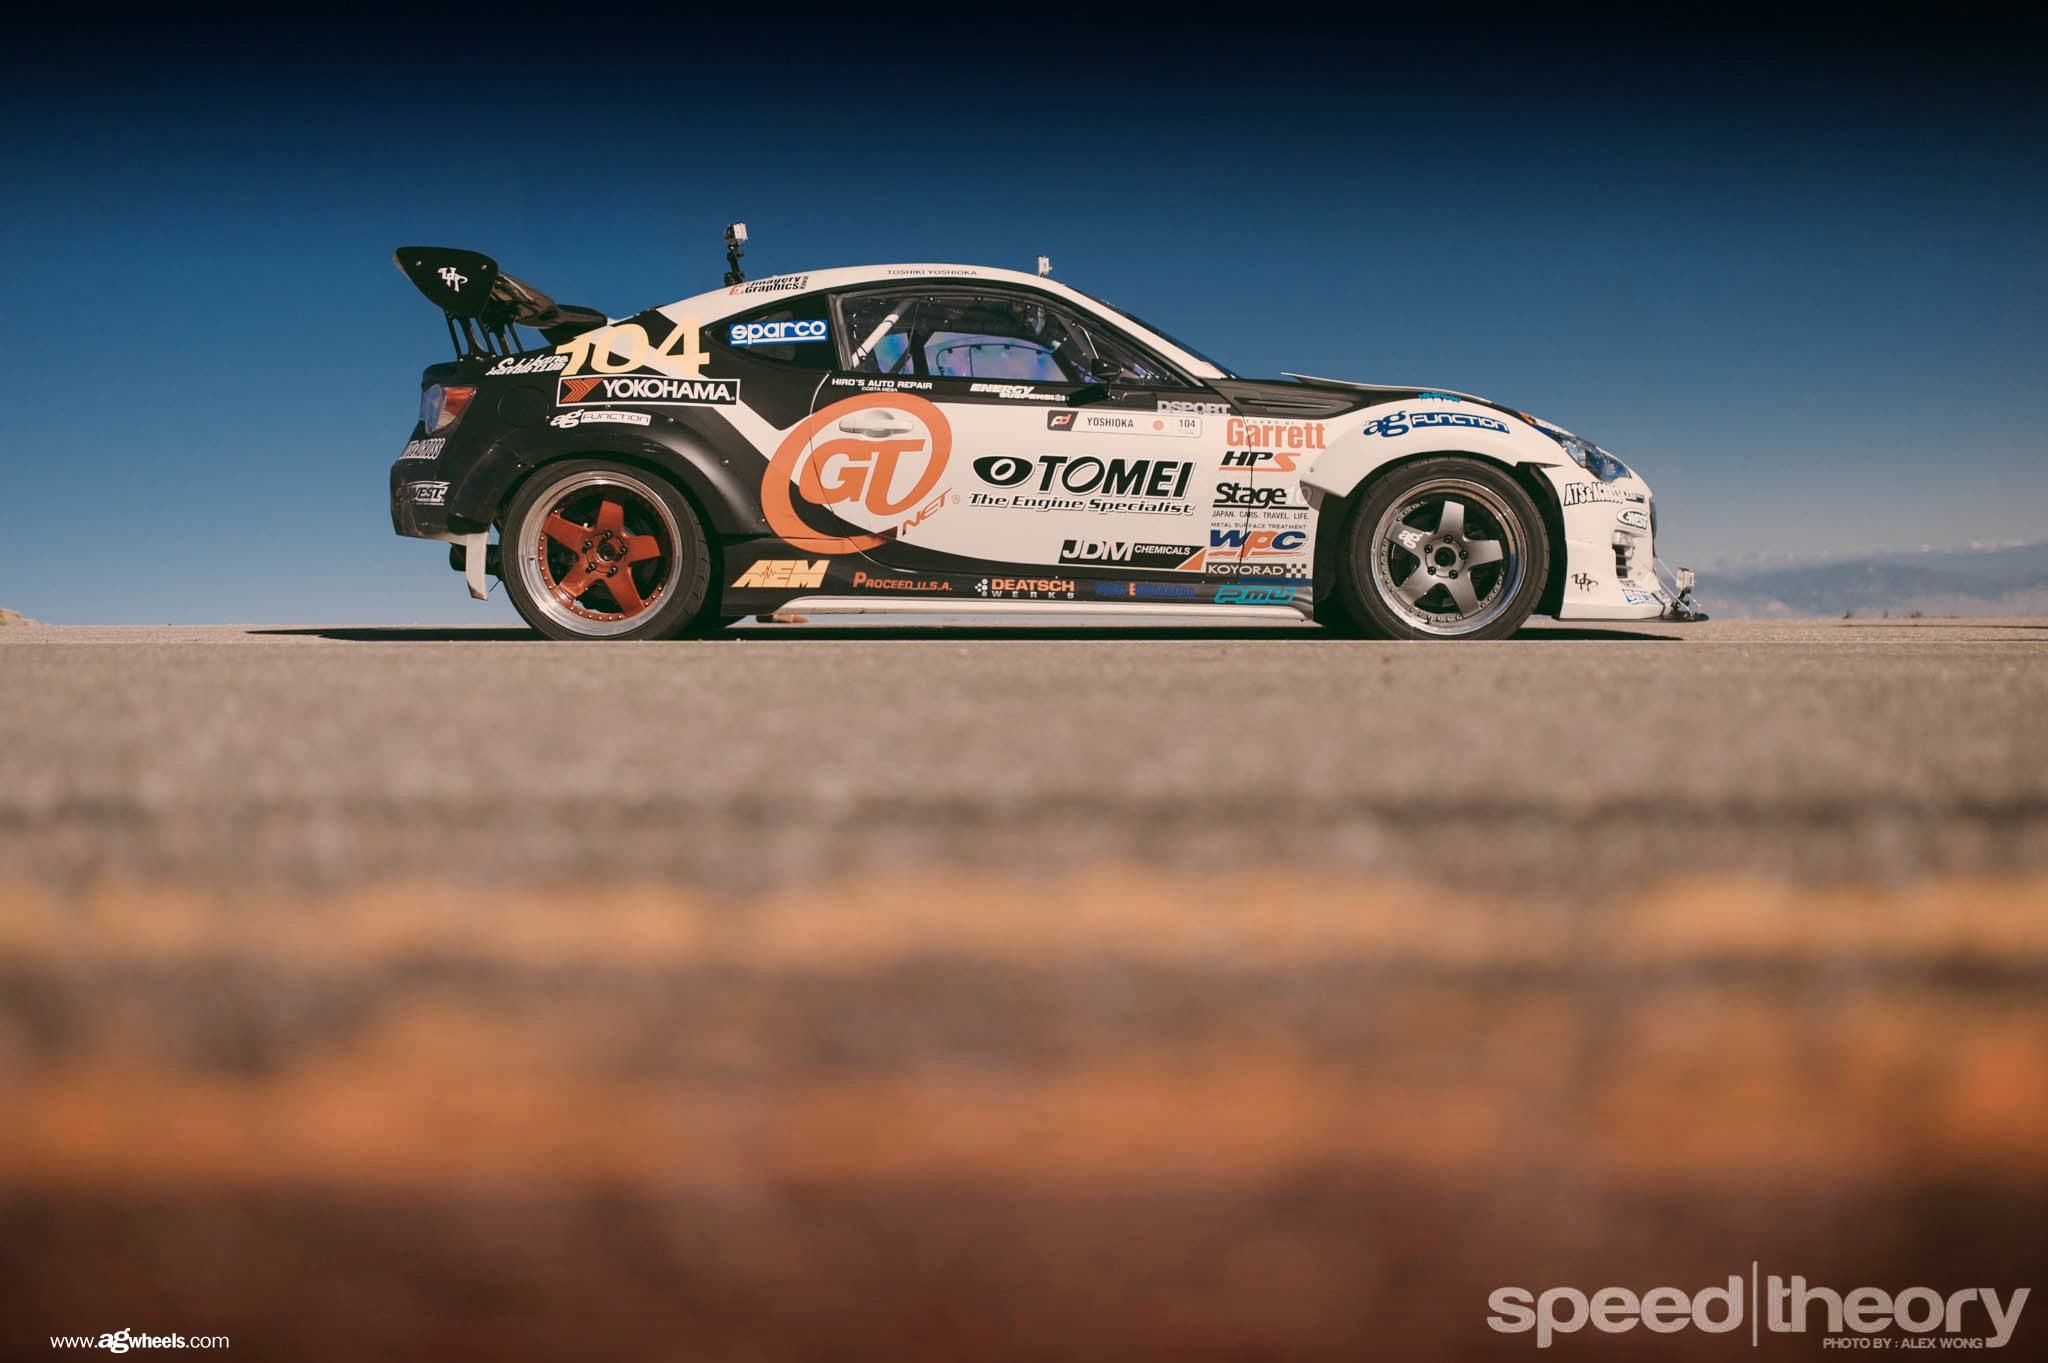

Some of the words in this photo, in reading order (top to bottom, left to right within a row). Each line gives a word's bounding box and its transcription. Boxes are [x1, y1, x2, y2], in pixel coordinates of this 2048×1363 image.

[744, 282, 800, 294] Graphics
[730, 320, 827, 345] sparco
[555, 315, 710, 376] 104
[831, 378, 865, 387] HIRO'S
[867, 379, 895, 389] AUTO
[897, 380, 933, 390] REPAIR
[1157, 400, 1231, 414] DSPORT
[1086, 416, 1134, 428] YOSHIOKA
[1179, 419, 1196, 428] 104
[1226, 418, 1326, 449] Garrett
[1219, 451, 1301, 472] HPS
[1038, 455, 1194, 498] TOMEI
[969, 493, 1008, 506] The
[1012, 495, 1084, 510] Engine
[1088, 498, 1195, 514] Specialist
[1211, 510, 1235, 518] JAPAN.
[1263, 512, 1291, 520] TRAVEL.
[1062, 540, 1135, 561] JDM
[1134, 544, 1191, 556] CHEMICALS
[731, 559, 831, 588] AEM
[1207, 563, 1285, 576] KOYORAD
[912, 580, 953, 591] U.S.A.
[991, 579, 1075, 592] DEATSCH
